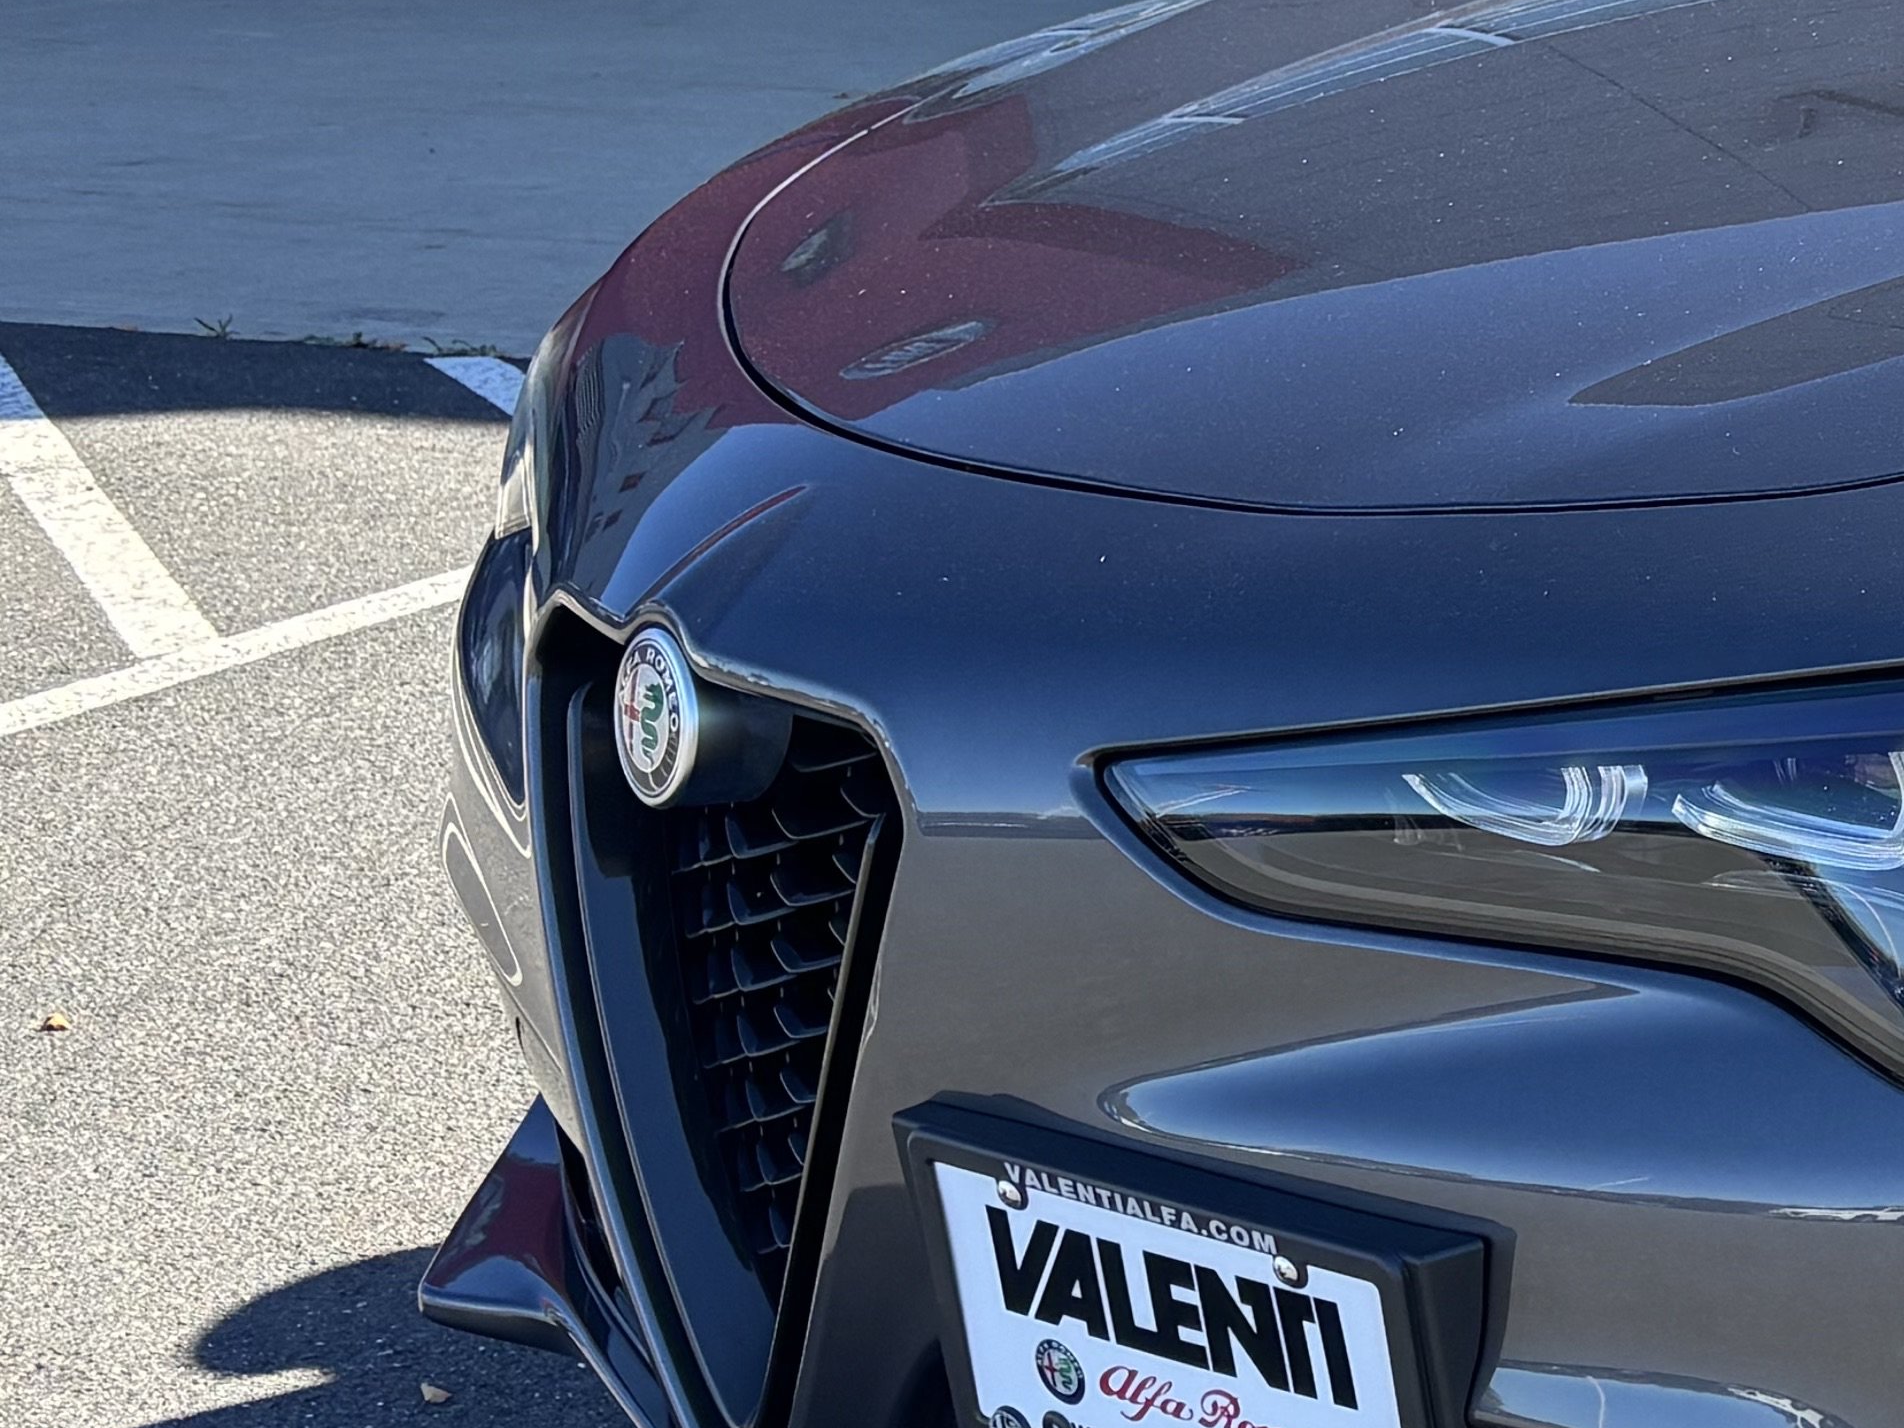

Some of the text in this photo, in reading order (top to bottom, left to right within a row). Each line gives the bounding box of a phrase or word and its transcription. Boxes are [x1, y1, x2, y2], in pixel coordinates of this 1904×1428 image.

[646, 647, 679, 732] ROMEO
[1004, 1161, 1278, 1257] VALENTIALFA.COM
[985, 1204, 1360, 1411] VALENTI
[1100, 1364, 1195, 1423] Alfa
